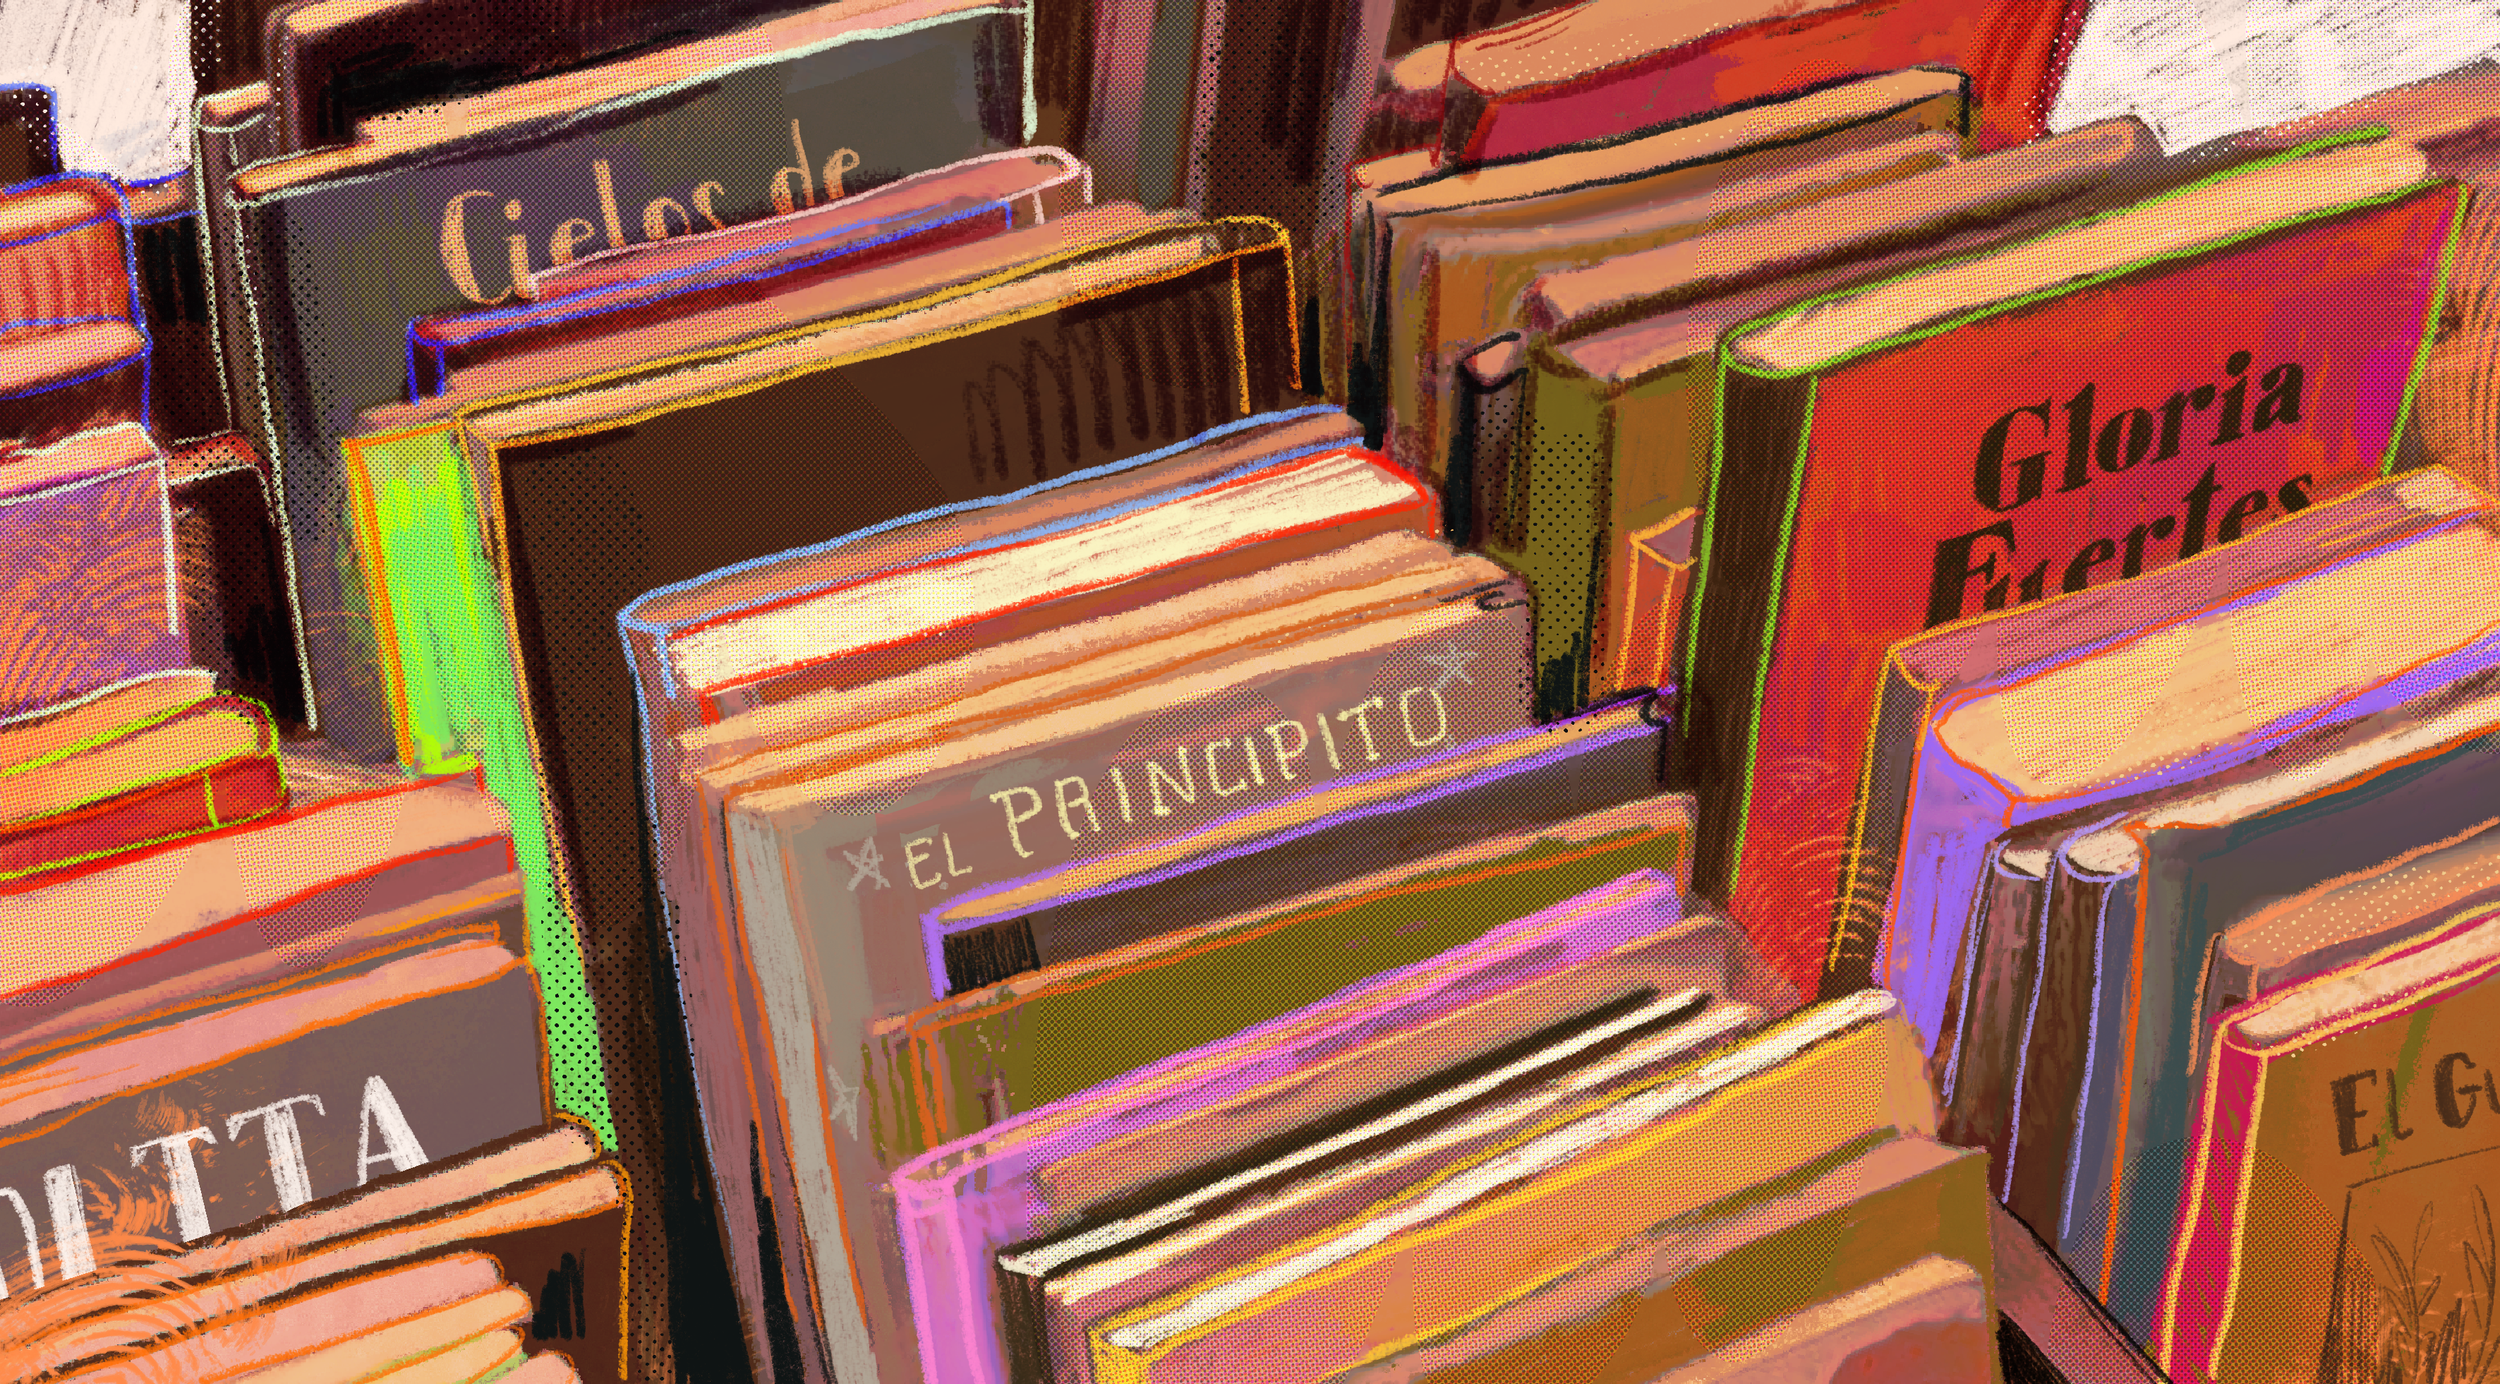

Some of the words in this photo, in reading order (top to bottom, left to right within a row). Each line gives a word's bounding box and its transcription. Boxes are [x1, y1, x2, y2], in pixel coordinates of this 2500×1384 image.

[440, 158, 727, 305] Cielos
[769, 118, 861, 215] de
[1973, 350, 2304, 512] Gloria
[1924, 463, 2313, 629] Fuertes
[904, 832, 973, 889] EL
[990, 686, 1448, 858] PRINCIPITO
